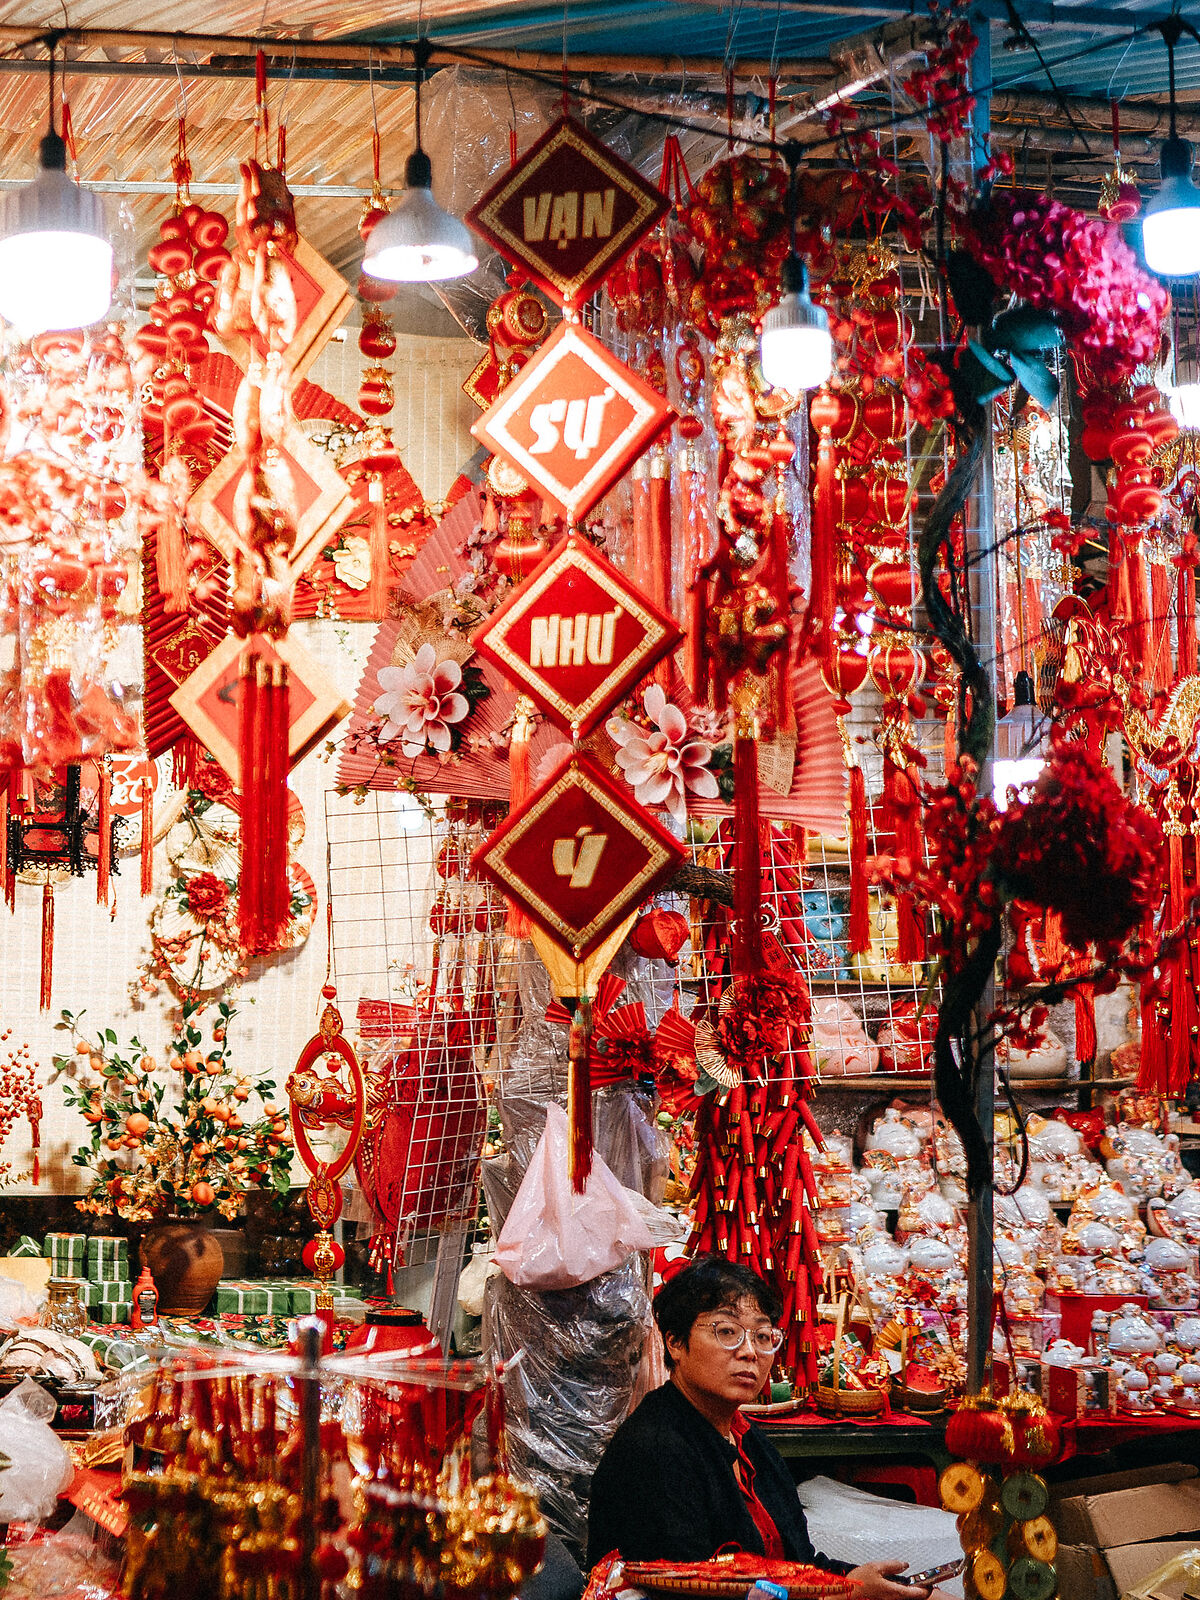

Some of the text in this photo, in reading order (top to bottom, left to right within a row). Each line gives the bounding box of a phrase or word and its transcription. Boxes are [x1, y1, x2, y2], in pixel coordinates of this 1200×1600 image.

[522, 188, 616, 250] VẠN
[528, 386, 617, 460] SỰ
[529, 605, 624, 669] NHƯ
[551, 825, 609, 889] Ý
